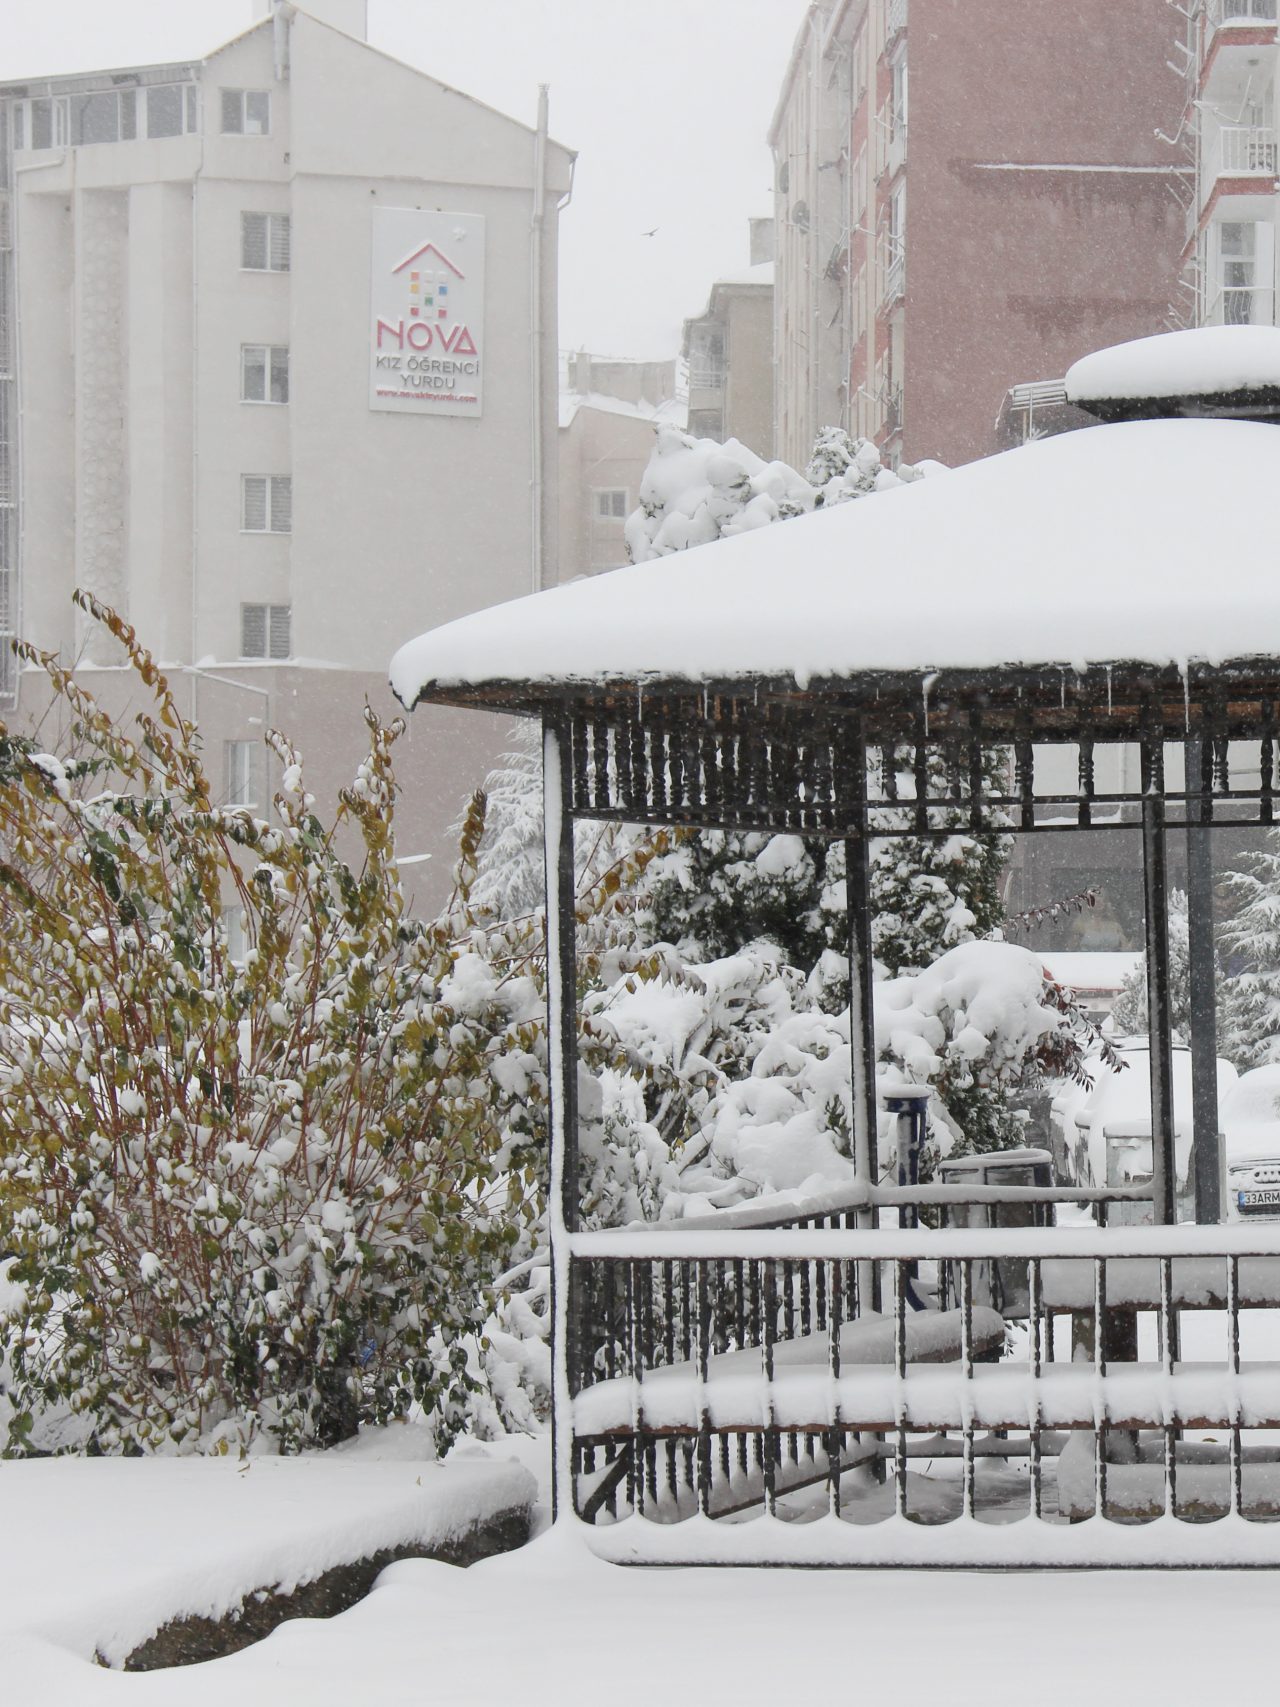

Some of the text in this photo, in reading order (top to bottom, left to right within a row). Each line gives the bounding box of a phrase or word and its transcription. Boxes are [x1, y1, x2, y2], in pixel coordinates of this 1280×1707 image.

[377, 319, 477, 355] NOVA
[376, 355, 479, 376] KIZ ÖĞRENCİ
[400, 374, 455, 389] YURDU
